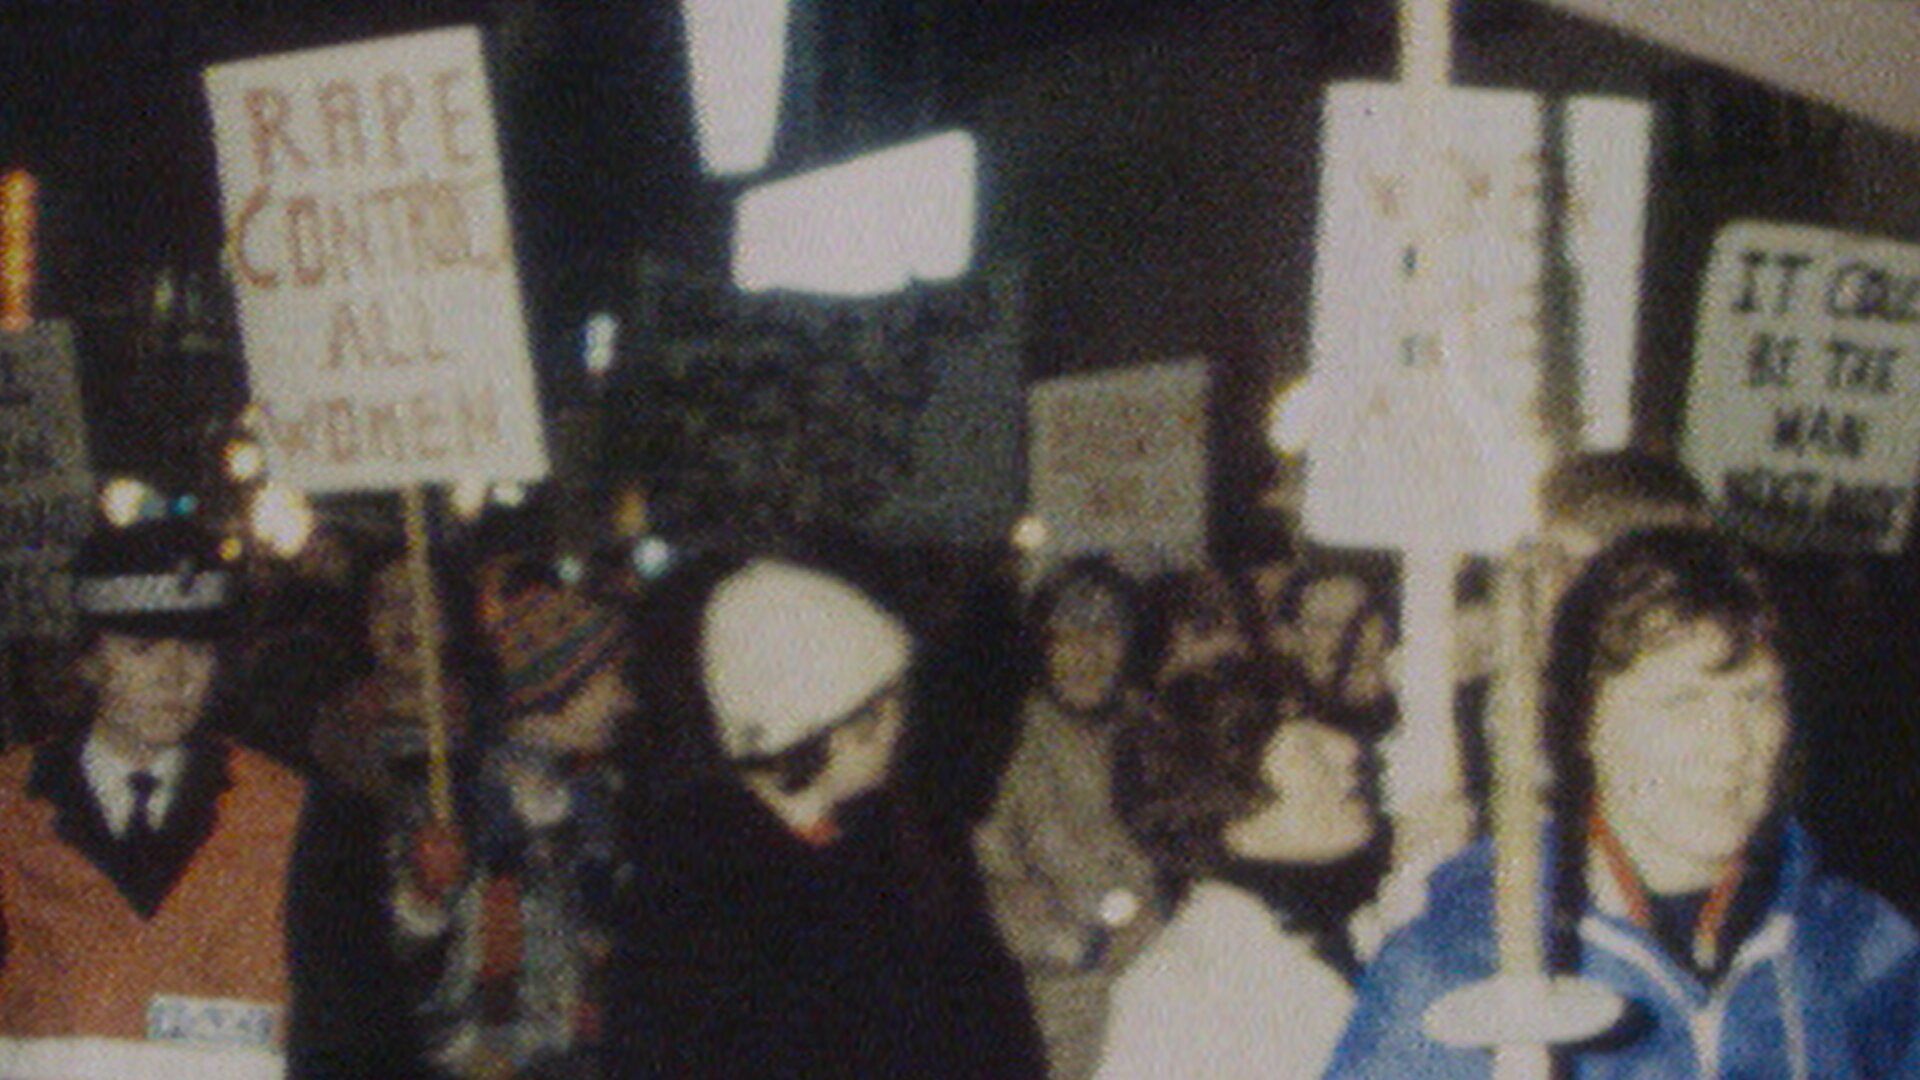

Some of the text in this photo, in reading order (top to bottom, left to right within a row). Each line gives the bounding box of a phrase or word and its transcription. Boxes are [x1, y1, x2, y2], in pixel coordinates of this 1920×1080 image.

[243, 66, 478, 175] RAPE
[1733, 250, 1812, 315] IT
[325, 298, 448, 369] ALL
[260, 383, 499, 463] WOMEN
